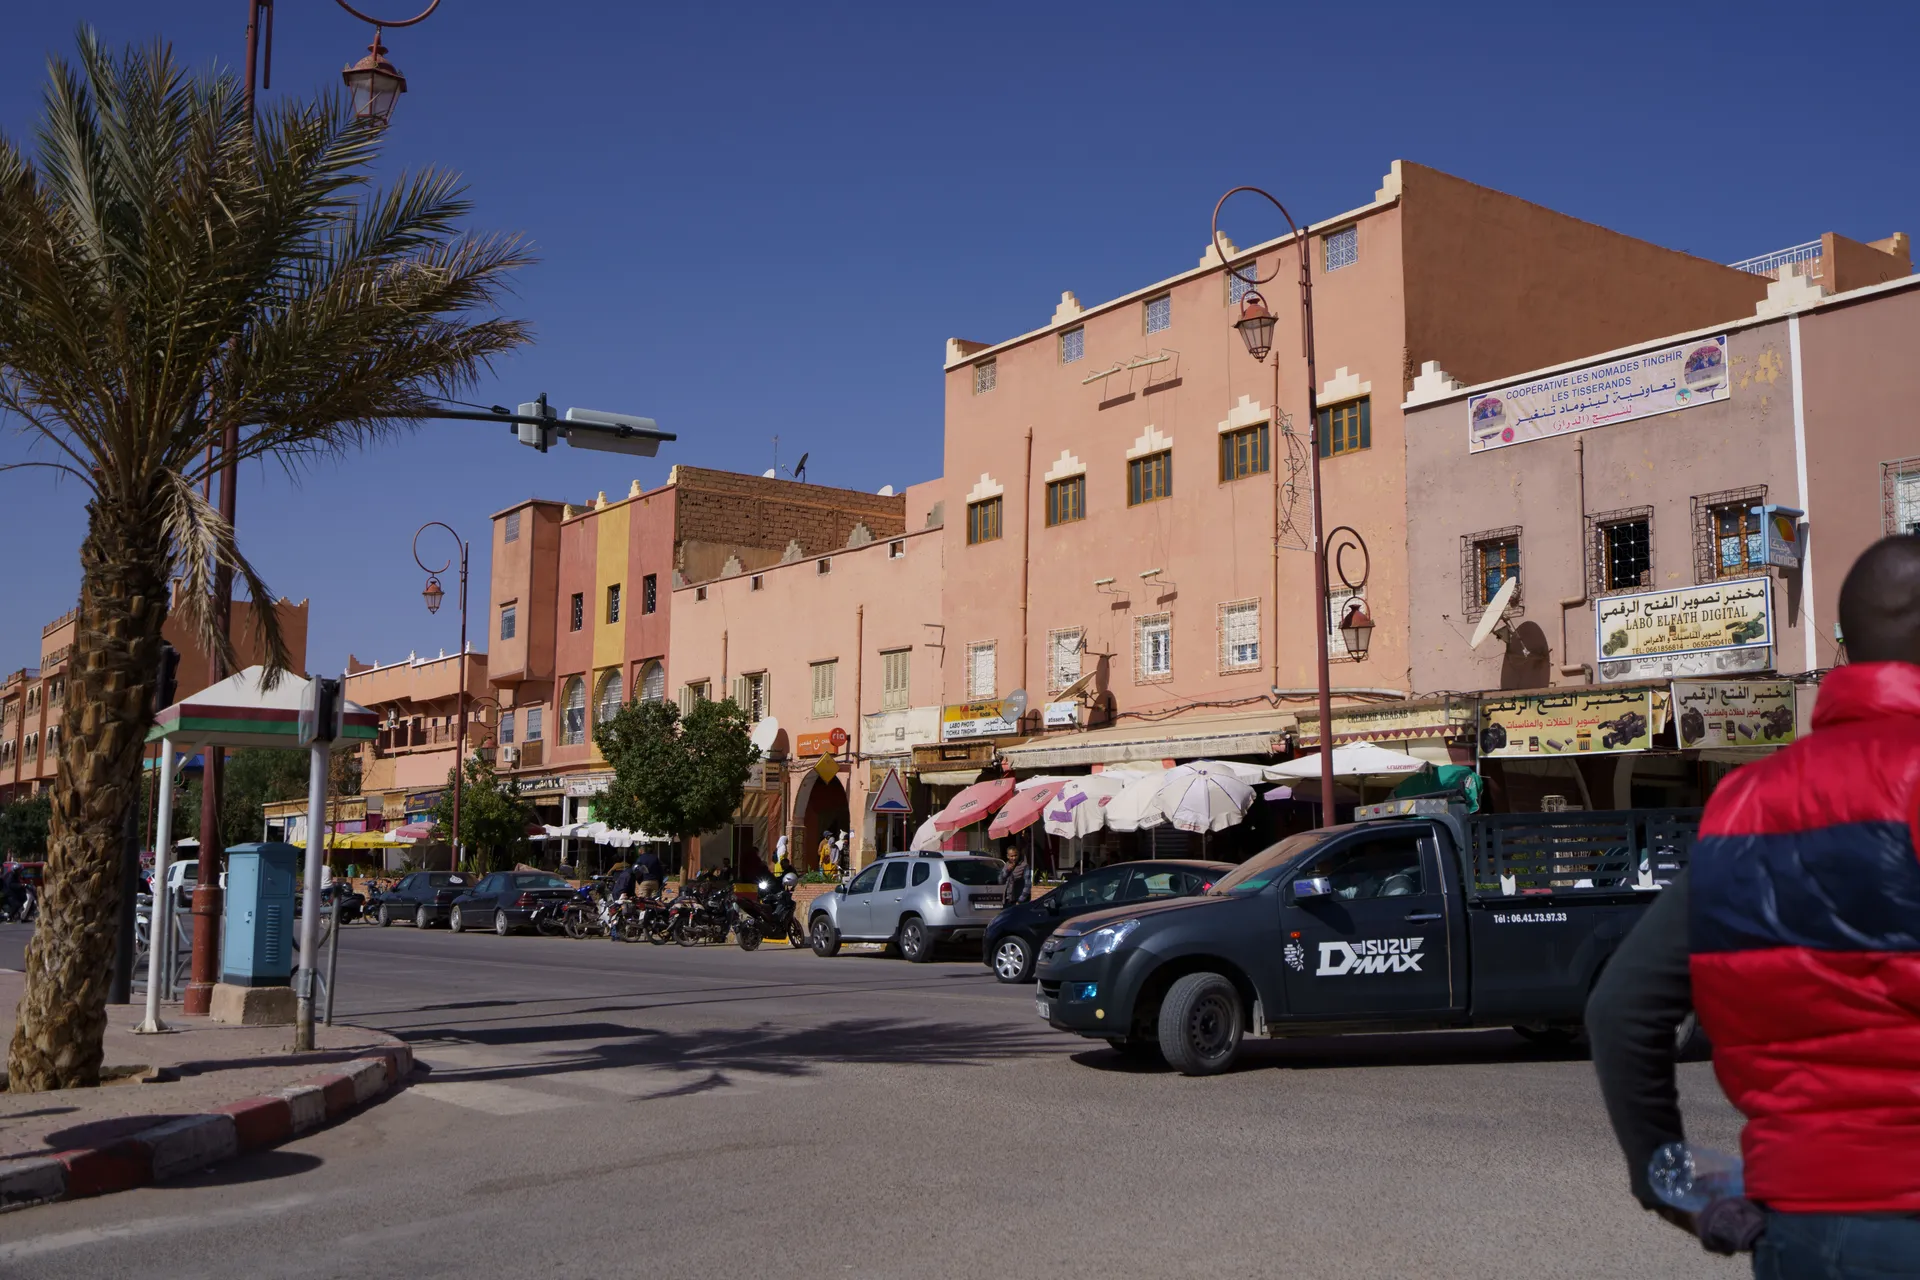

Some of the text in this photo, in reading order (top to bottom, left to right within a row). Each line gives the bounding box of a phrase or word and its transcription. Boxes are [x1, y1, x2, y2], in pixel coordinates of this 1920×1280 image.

[1571, 373, 1589, 385] LES
[1591, 361, 1639, 380] NOMADES
[1642, 350, 1683, 367] TINGHIR
[1552, 376, 1631, 402] LES TISSERANDS
[1516, 378, 1676, 426] تعاونية لينوماد تنغير
[1592, 405, 1632, 424] للنسيج
[1771, 551, 1799, 568] Konica
[1601, 588, 1765, 623] مختبر تصوير الفتح الرقمي
[1626, 605, 1748, 631] LABO ELFATH DIGITAL
[1672, 631, 1700, 643] المناسبات
[1702, 630, 1721, 640] تصوير
[1537, 692, 1578, 715] الفتح
[1581, 690, 1645, 711] مختبر
[1679, 687, 1717, 709] الرقمي
[1720, 686, 1750, 706] الفتح
[1752, 685, 1791, 704] مختبر
[1481, 695, 1531, 720] الرقمي
[960, 720, 975, 728] PHOTO
[1506, 715, 1600, 731] تصوير الحفلات والمناسبات
[832, 730, 845, 740] ria
[1493, 914, 1506, 924] Tél
[1511, 912, 1567, 923] 06.41.73.97.33
[1361, 938, 1411, 955] ISUZU
